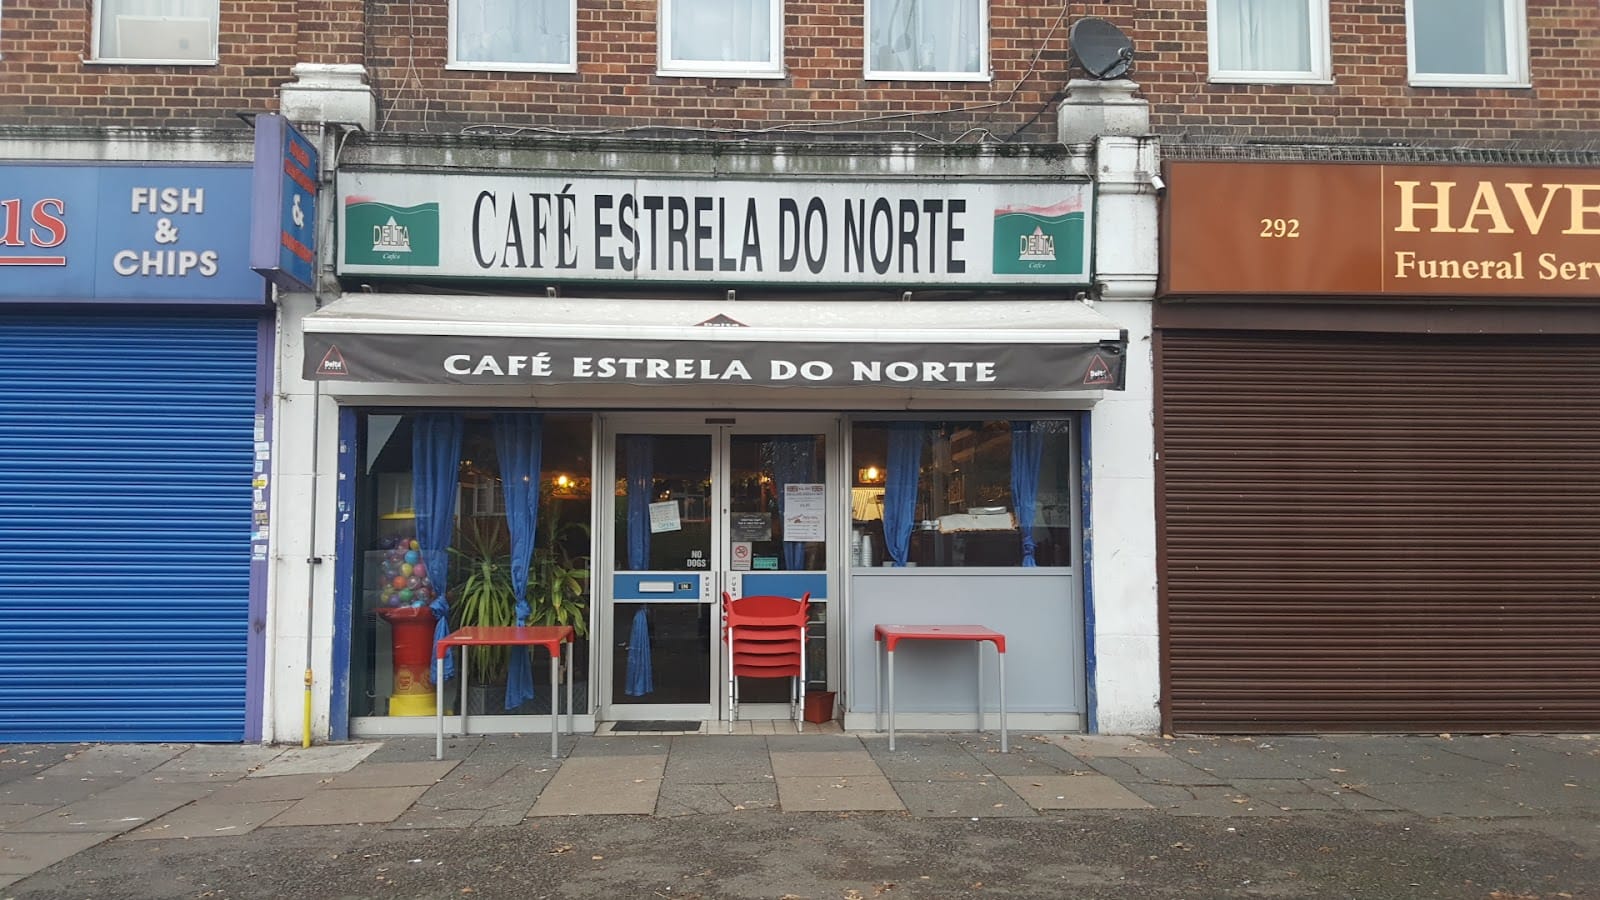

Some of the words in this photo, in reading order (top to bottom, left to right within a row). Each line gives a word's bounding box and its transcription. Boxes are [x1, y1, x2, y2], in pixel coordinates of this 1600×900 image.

[131, 187, 205, 215] FISH
[292, 193, 305, 229] &
[1394, 181, 1600, 236] HAVE
[154, 219, 179, 245] &
[372, 224, 411, 246] DELTA
[472, 183, 578, 269] CAFÉ
[595, 193, 763, 273] ESTRELA
[779, 196, 828, 275] DO
[844, 197, 966, 275] NORTE
[1259, 217, 1300, 239] 292
[1019, 234, 1055, 255] DELTA
[113, 249, 219, 278] CHIPS
[1394, 250, 1525, 280] Funeral
[443, 352, 552, 377] CAFÉ
[572, 357, 754, 381] ESTRELA
[770, 360, 834, 382] DO
[853, 361, 997, 383] NORTE
[686, 558, 707, 568] DOGS
[691, 550, 702, 559] NO
